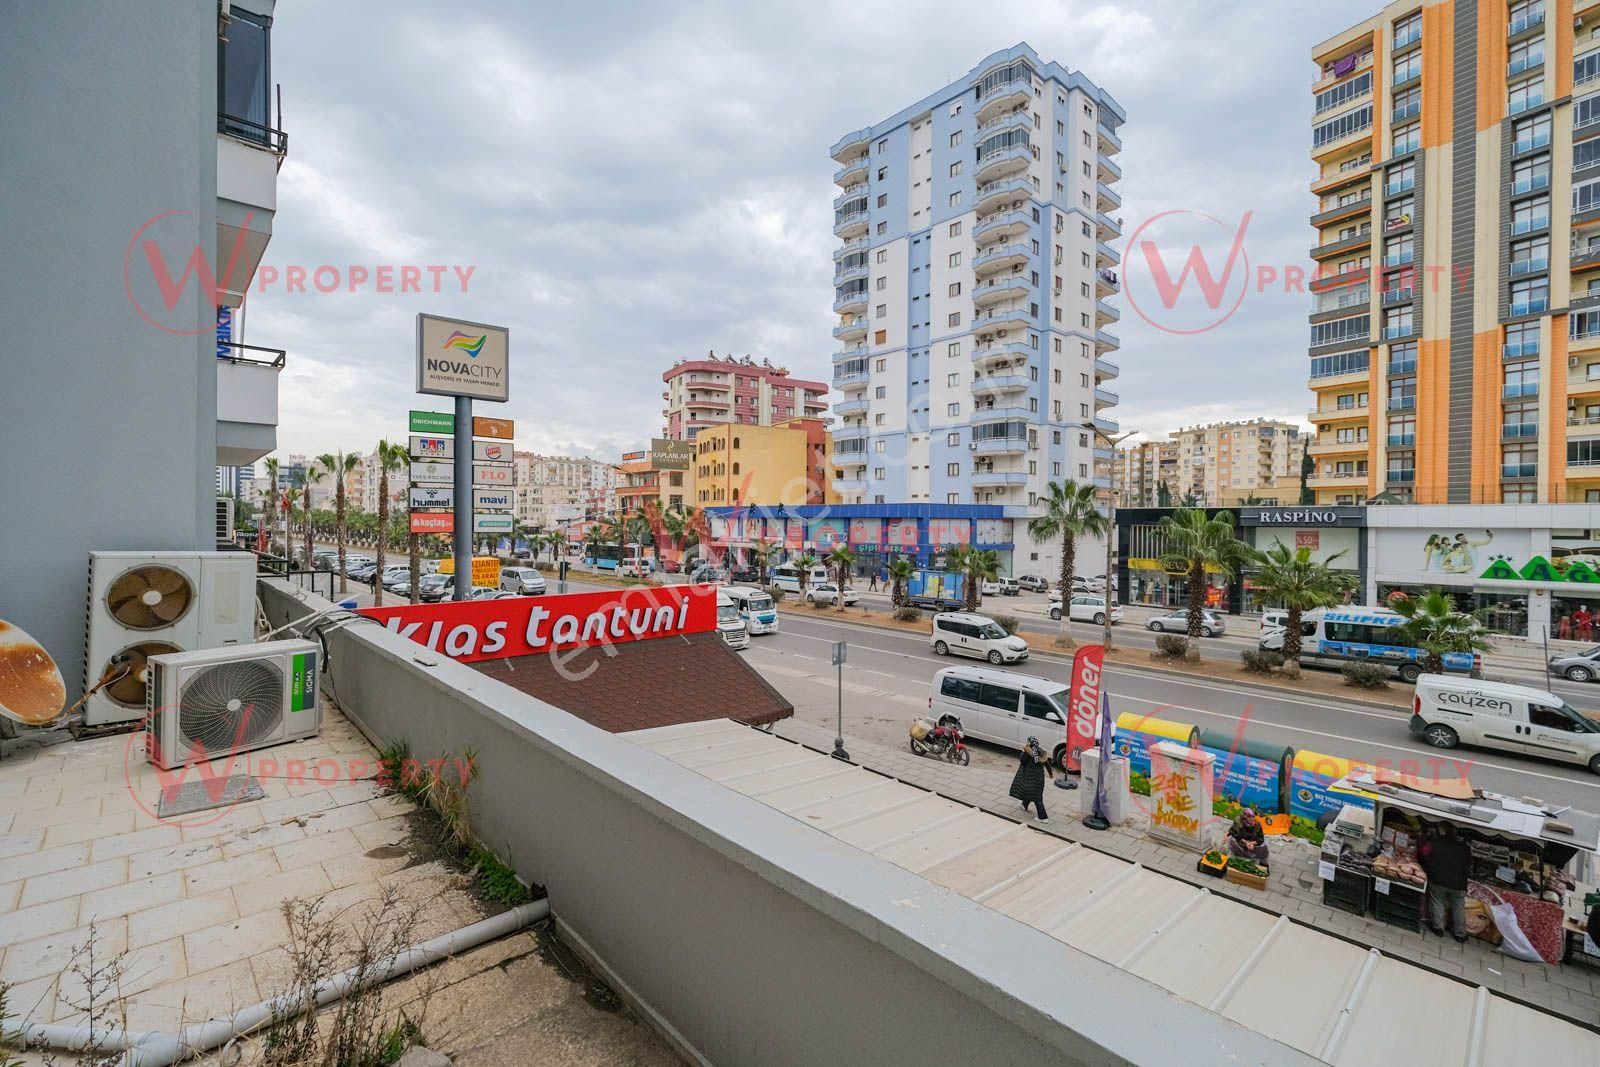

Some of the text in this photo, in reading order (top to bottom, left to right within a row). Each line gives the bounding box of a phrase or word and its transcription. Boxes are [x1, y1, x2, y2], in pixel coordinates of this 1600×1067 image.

[427, 358, 502, 379] NOVACITY
[481, 471, 506, 480] FLO
[413, 498, 449, 506] hummel
[480, 495, 507, 504] mavi
[1260, 509, 1337, 523] RASPİNO
[524, 595, 690, 647] tantuni
[1072, 655, 1101, 739] döner
[1438, 691, 1513, 715] çayzen
